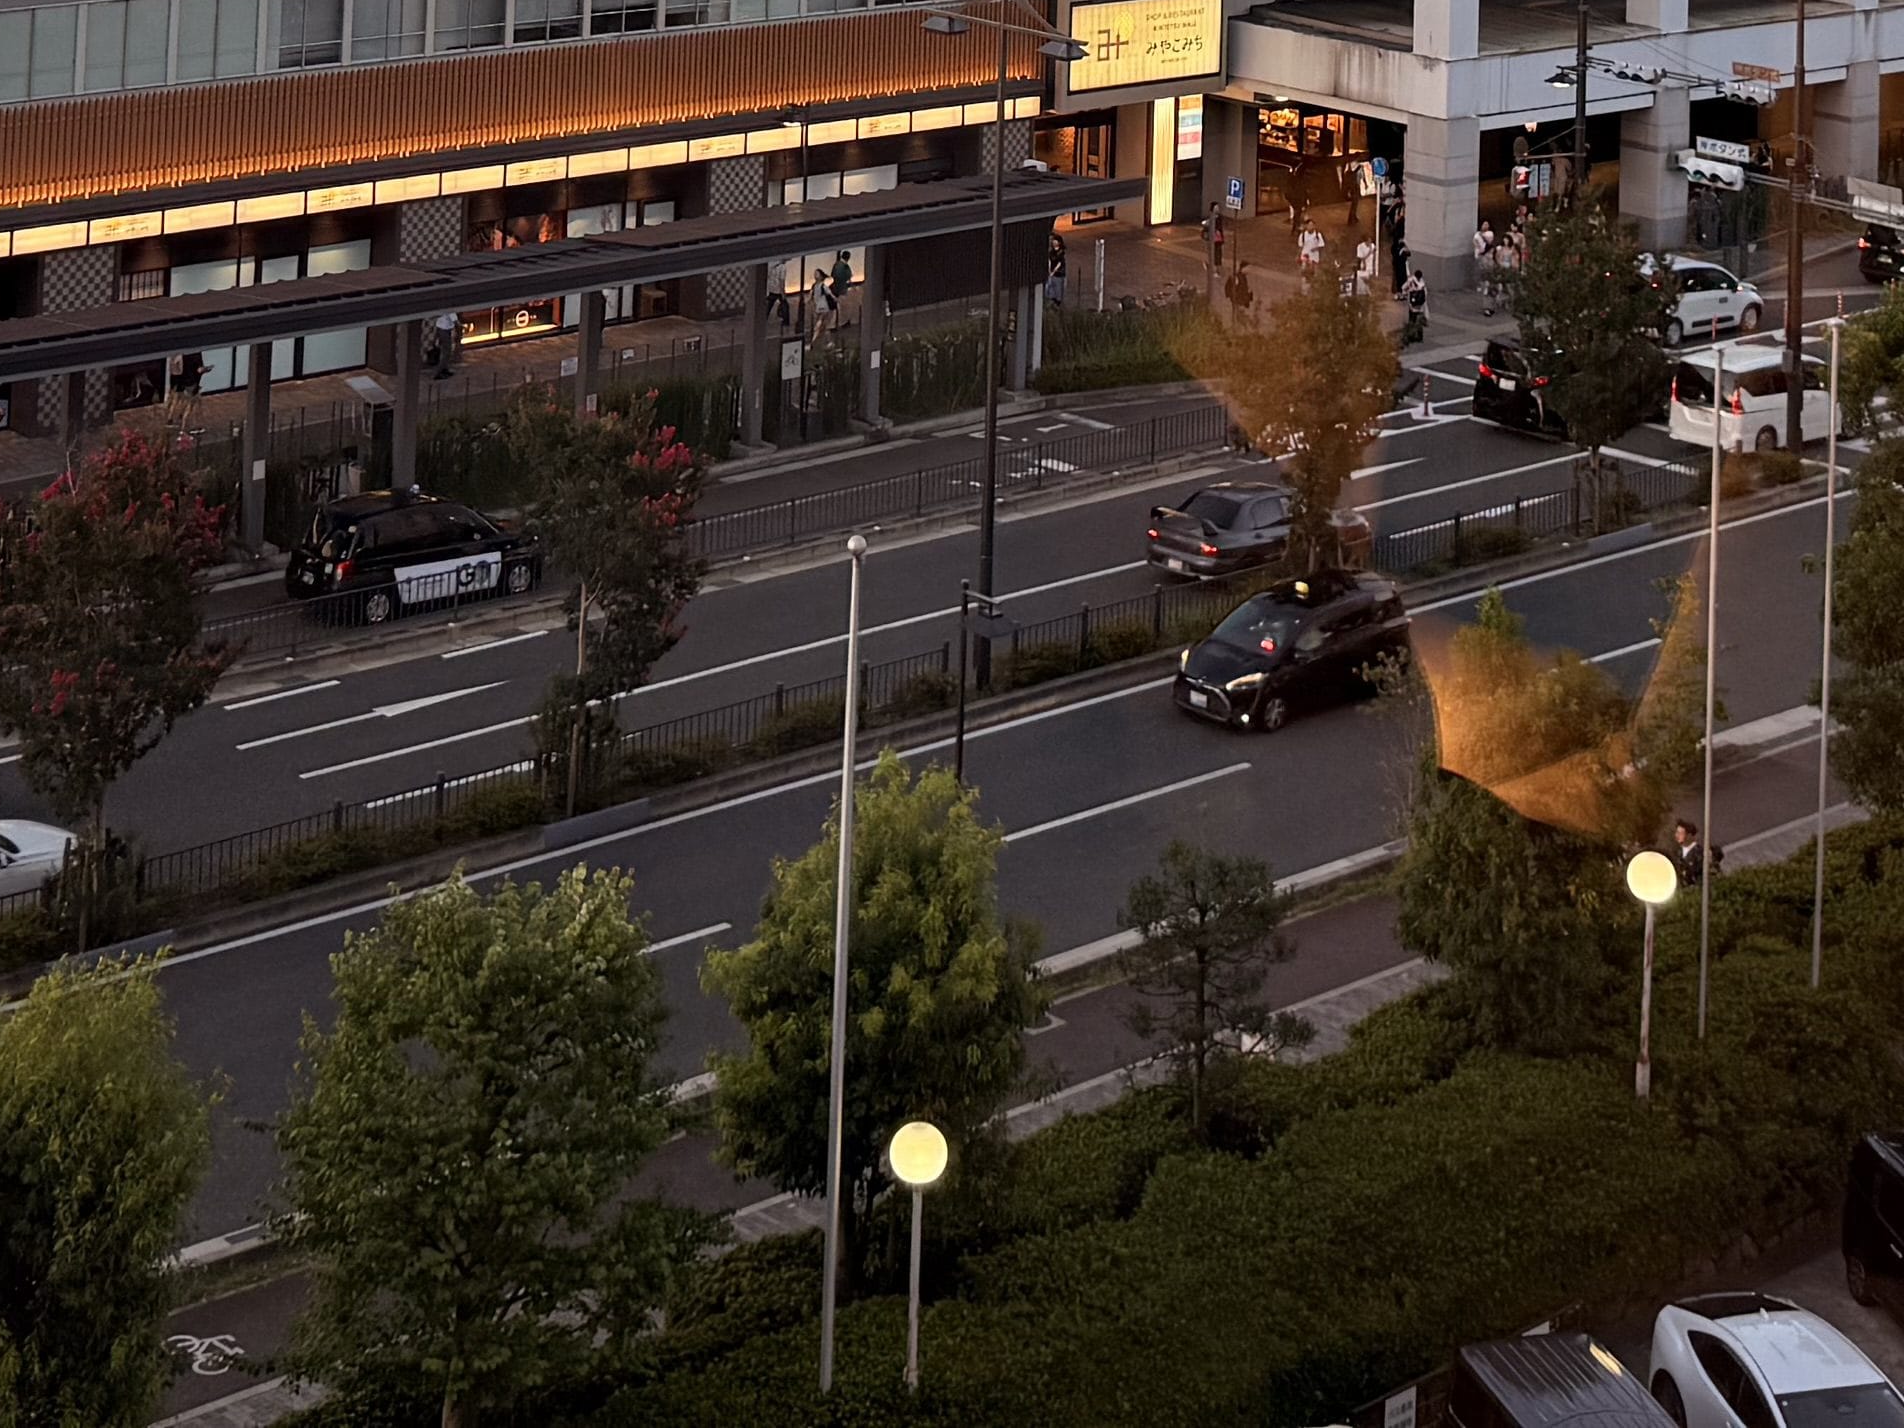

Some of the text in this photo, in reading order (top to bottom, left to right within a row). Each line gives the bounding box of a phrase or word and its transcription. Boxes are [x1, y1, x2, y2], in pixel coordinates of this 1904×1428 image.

[1146, 34, 1203, 56] みやこみち
[1230, 179, 1240, 195] P
